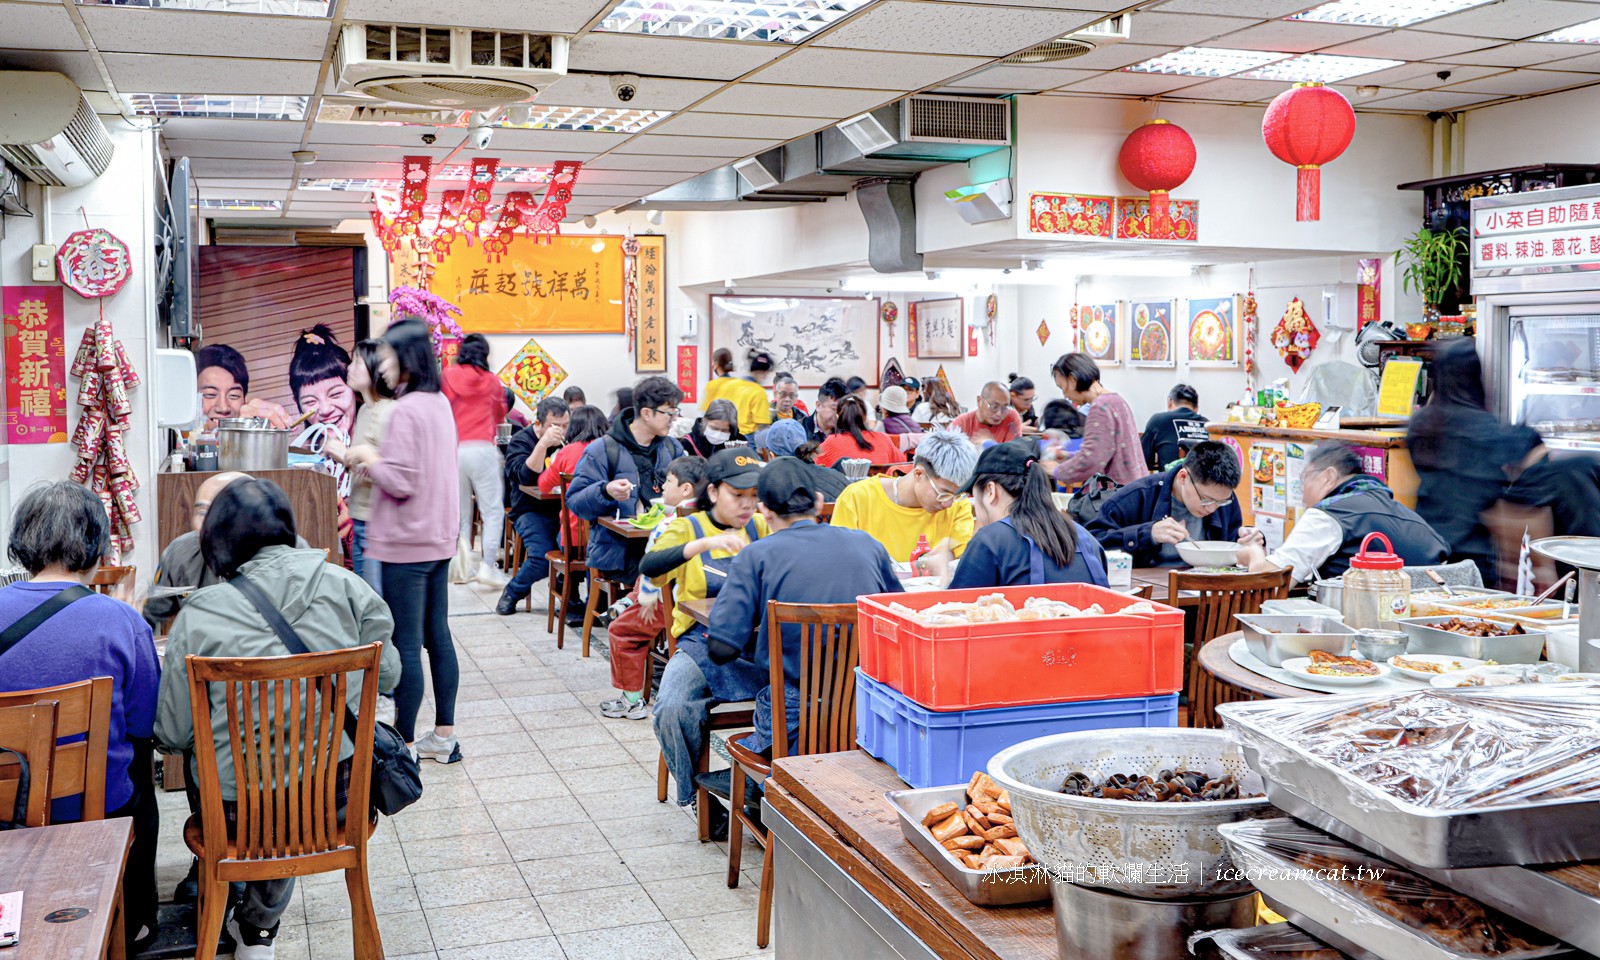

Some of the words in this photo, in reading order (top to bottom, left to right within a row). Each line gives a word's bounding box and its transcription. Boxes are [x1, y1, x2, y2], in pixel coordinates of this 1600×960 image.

[17, 299, 51, 417] 恭賀新禧
[517, 356, 547, 391] 福
